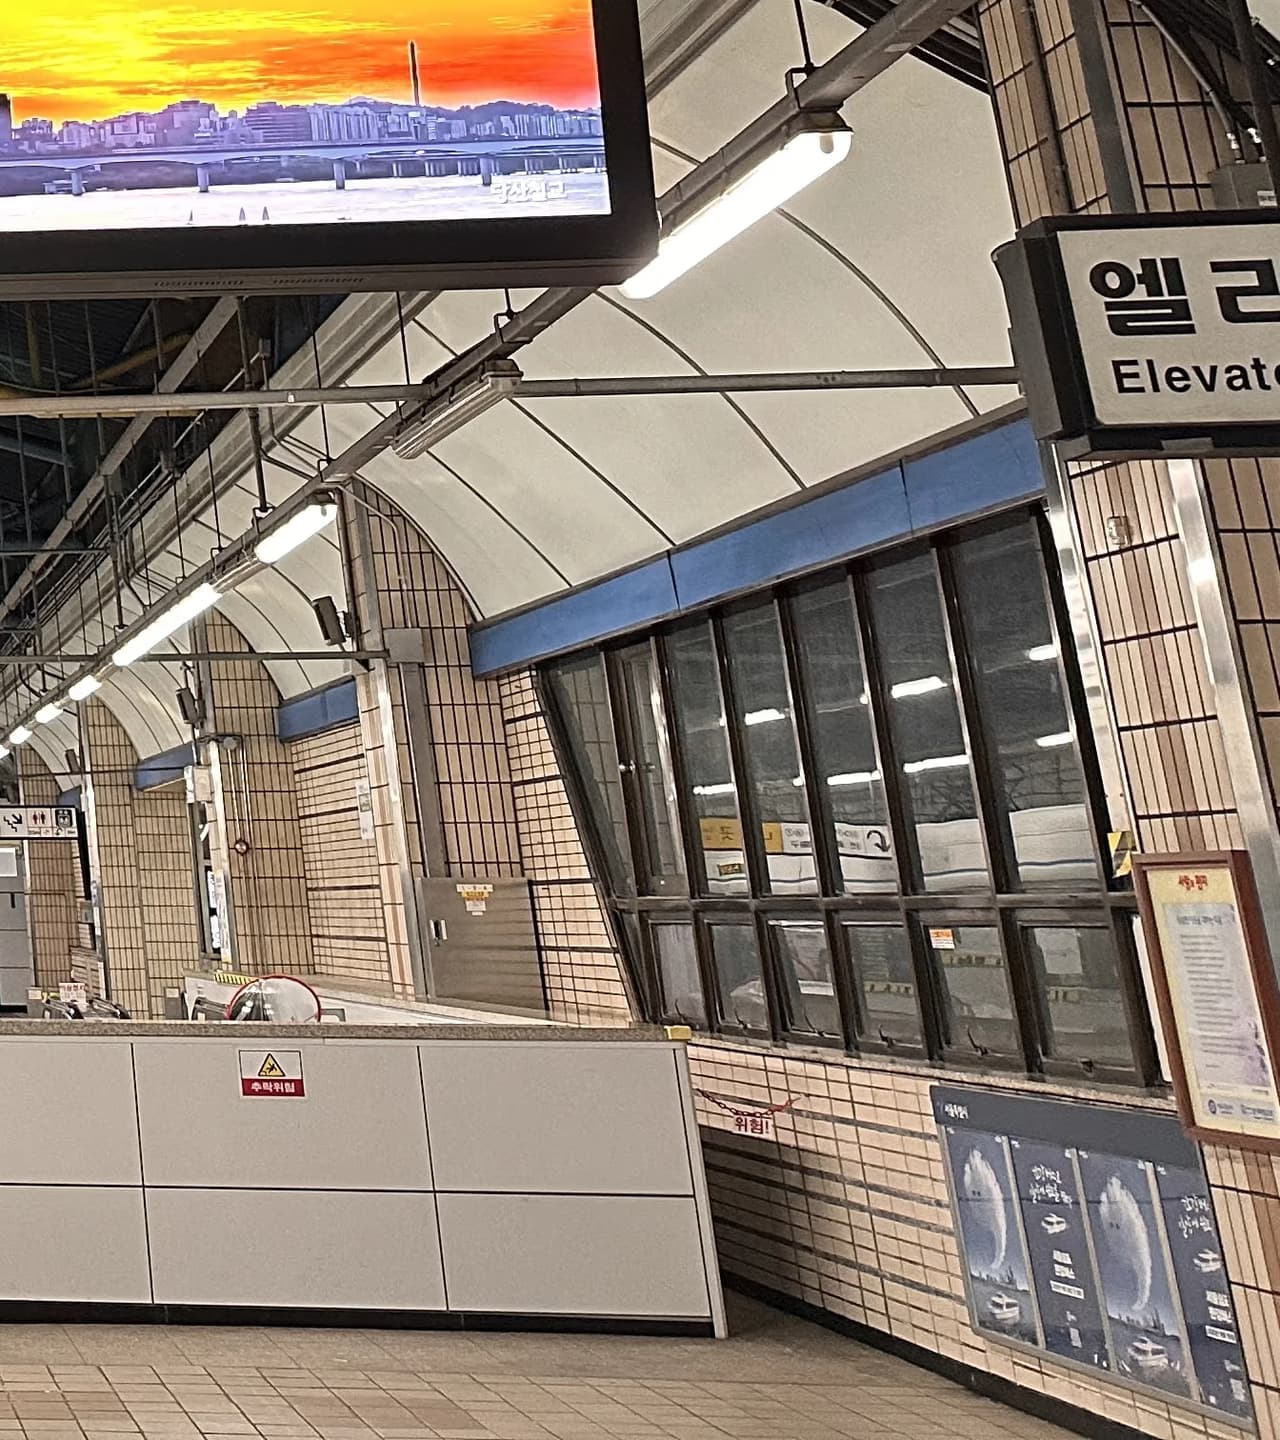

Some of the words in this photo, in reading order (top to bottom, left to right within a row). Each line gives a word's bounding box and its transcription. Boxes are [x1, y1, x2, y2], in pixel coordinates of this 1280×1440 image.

[1112, 357, 1280, 395] Elevat
[251, 1081, 296, 1093] 추락위험
[735, 1117, 770, 1134] 위험!
